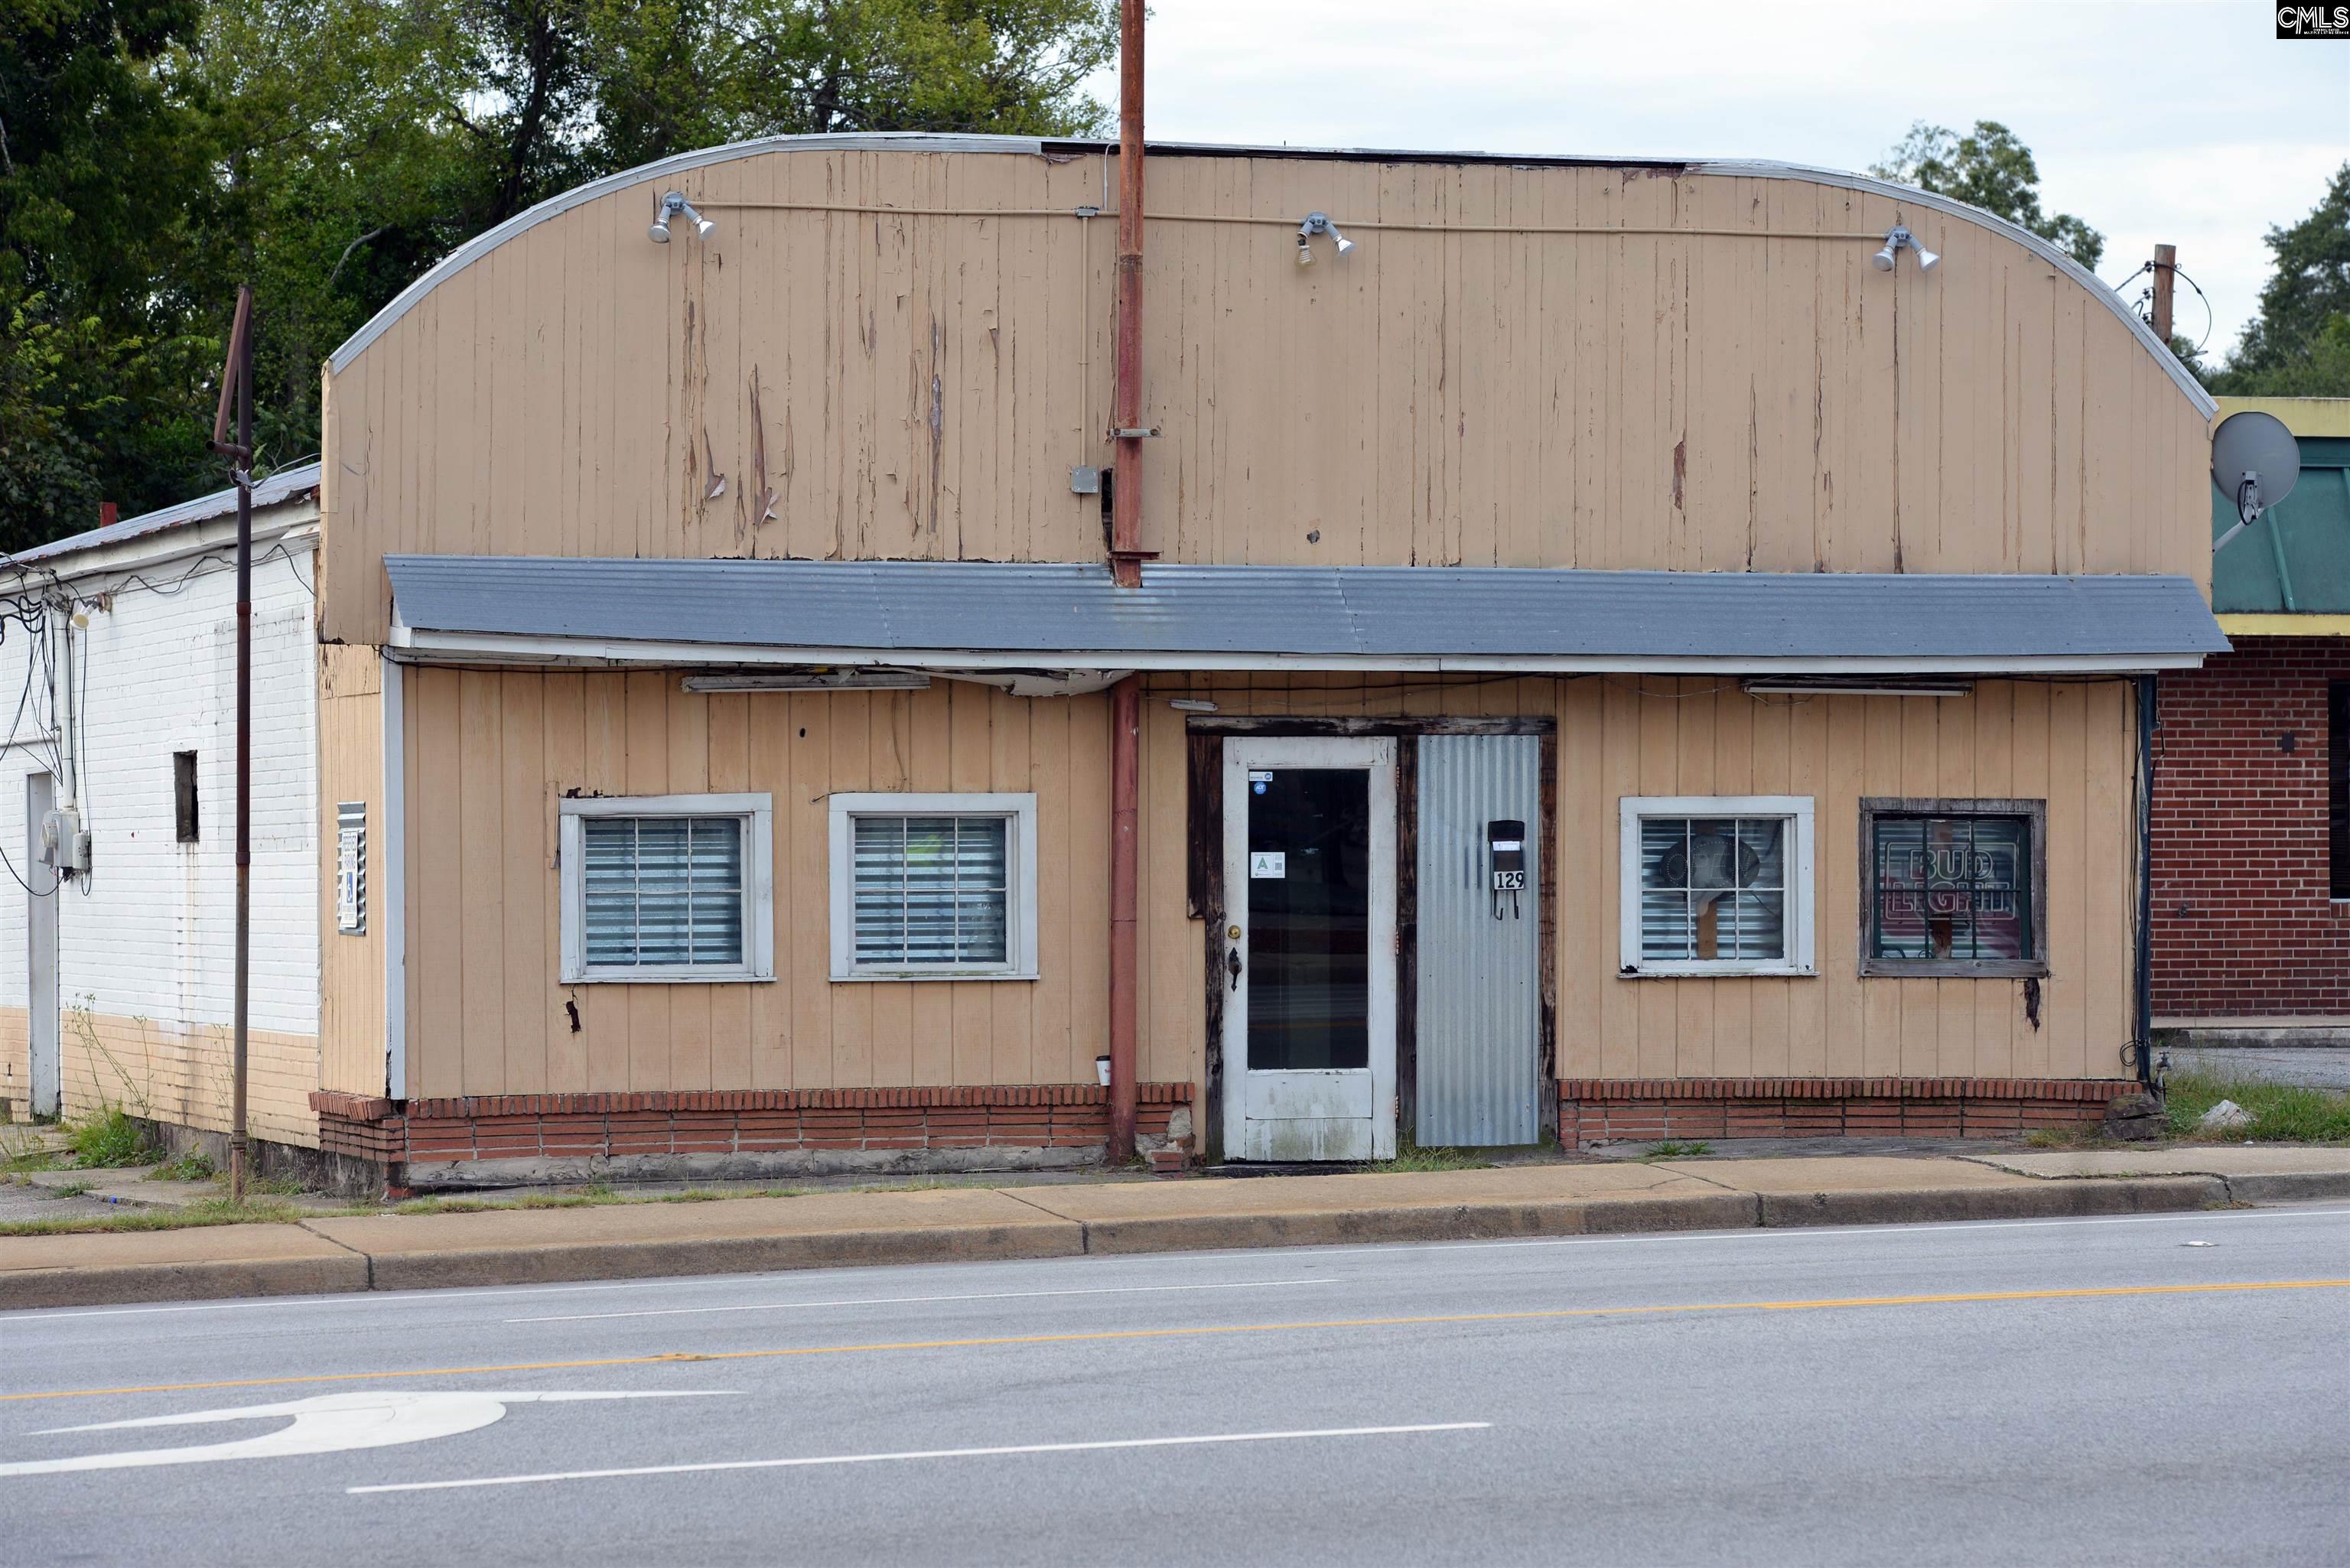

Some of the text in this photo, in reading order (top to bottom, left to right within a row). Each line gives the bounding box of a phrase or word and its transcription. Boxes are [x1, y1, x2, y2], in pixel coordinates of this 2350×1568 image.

[343, 834, 356, 851] RESERVED
[343, 853, 356, 870] PARKING
[1257, 856, 1268, 870] A
[1909, 850, 1994, 880] BUD
[1497, 872, 1524, 889] 129
[1892, 881, 2010, 912] LIGHT
